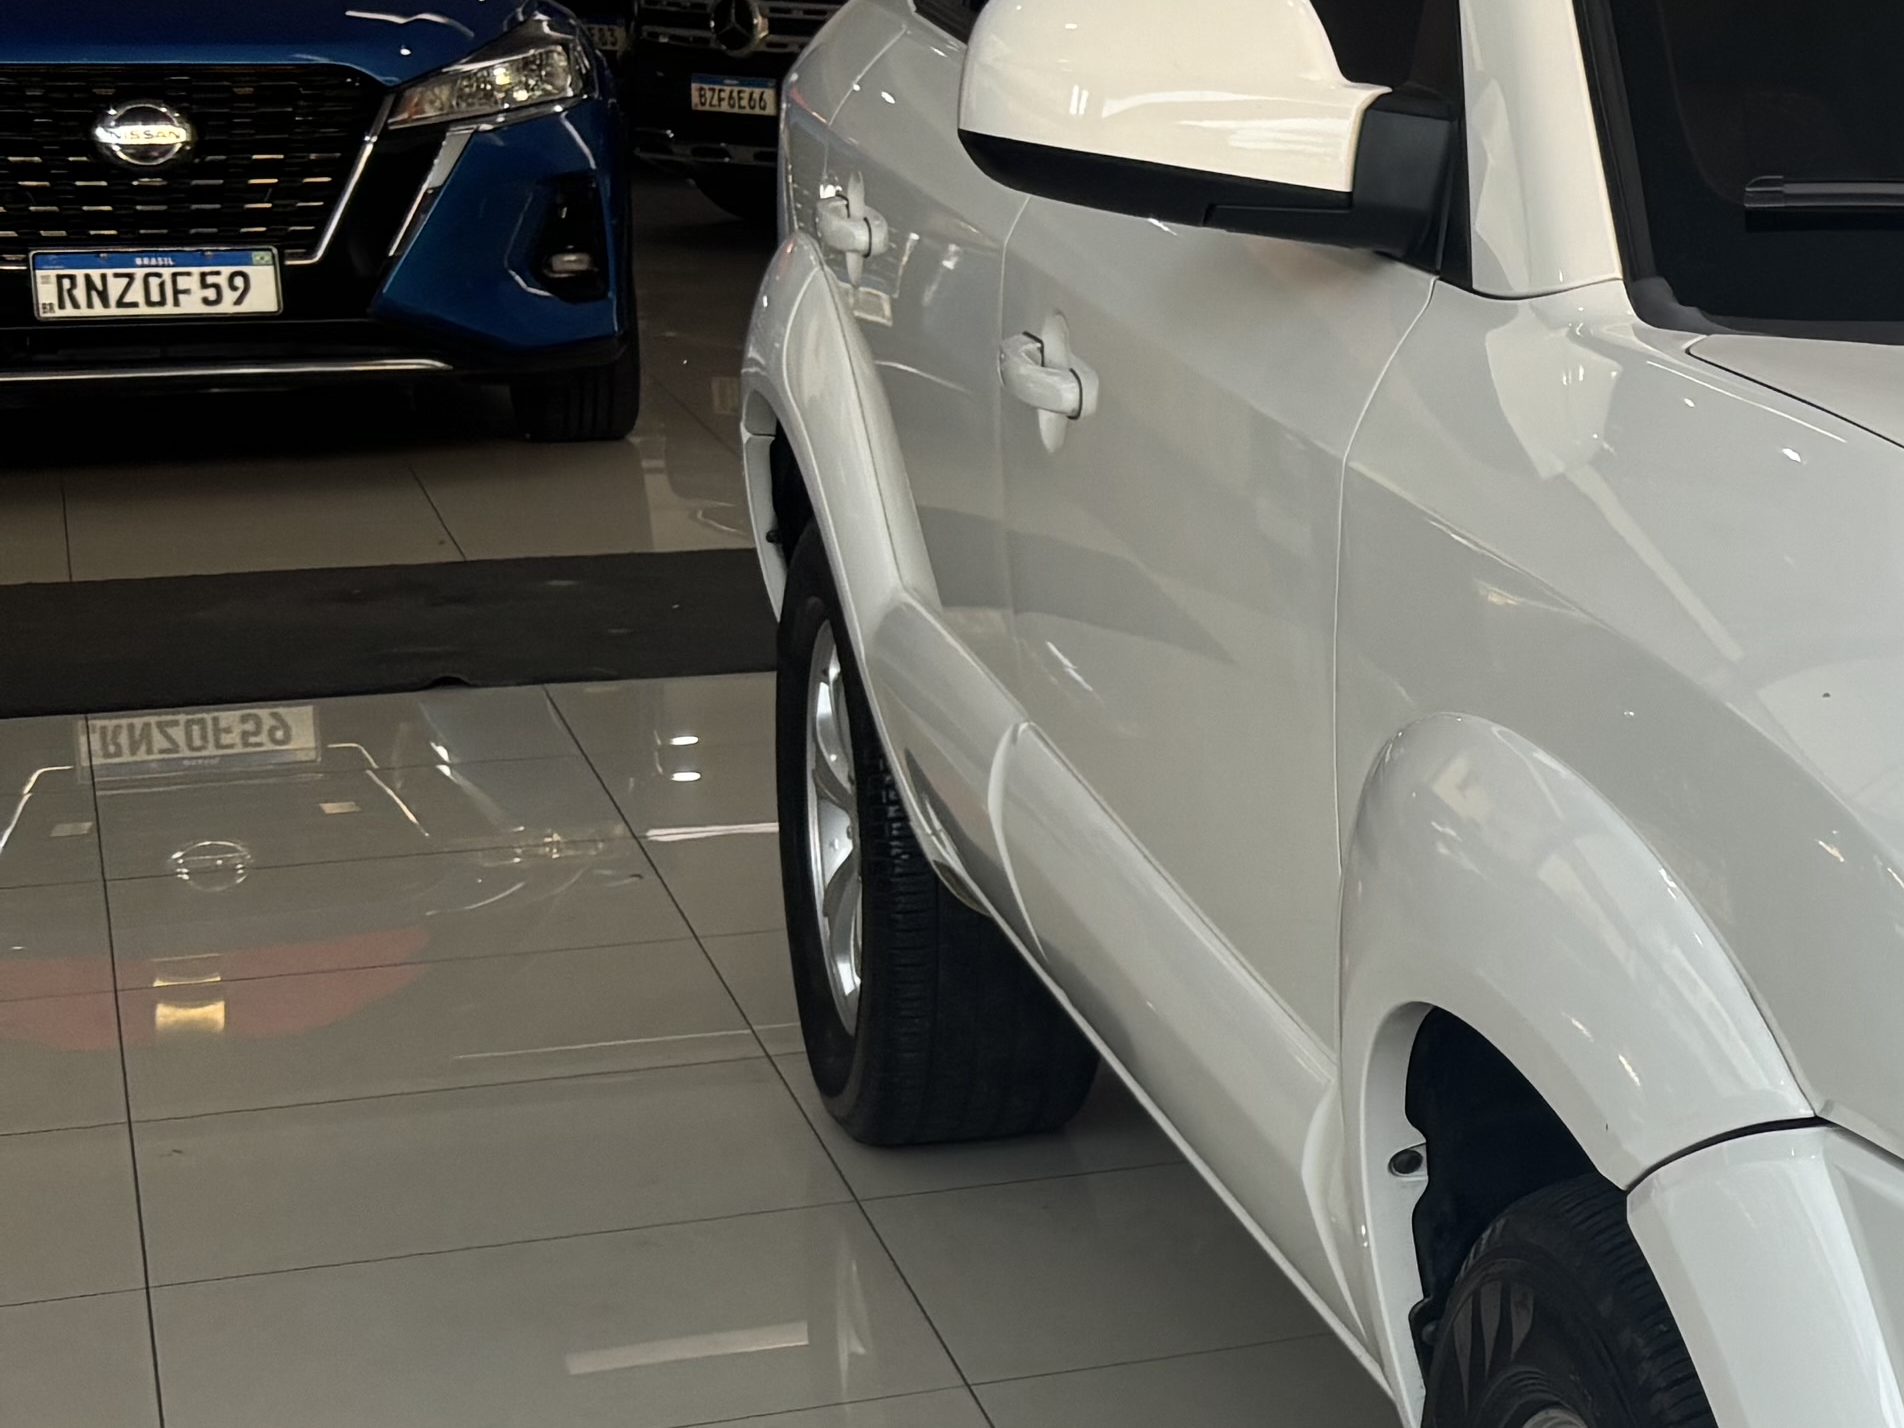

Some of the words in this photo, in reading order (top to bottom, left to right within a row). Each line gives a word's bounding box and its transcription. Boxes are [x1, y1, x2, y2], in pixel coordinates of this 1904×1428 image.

[698, 87, 767, 111] BZF6E66
[104, 127, 180, 140] NISSAN
[135, 256, 175, 267] BRASIL
